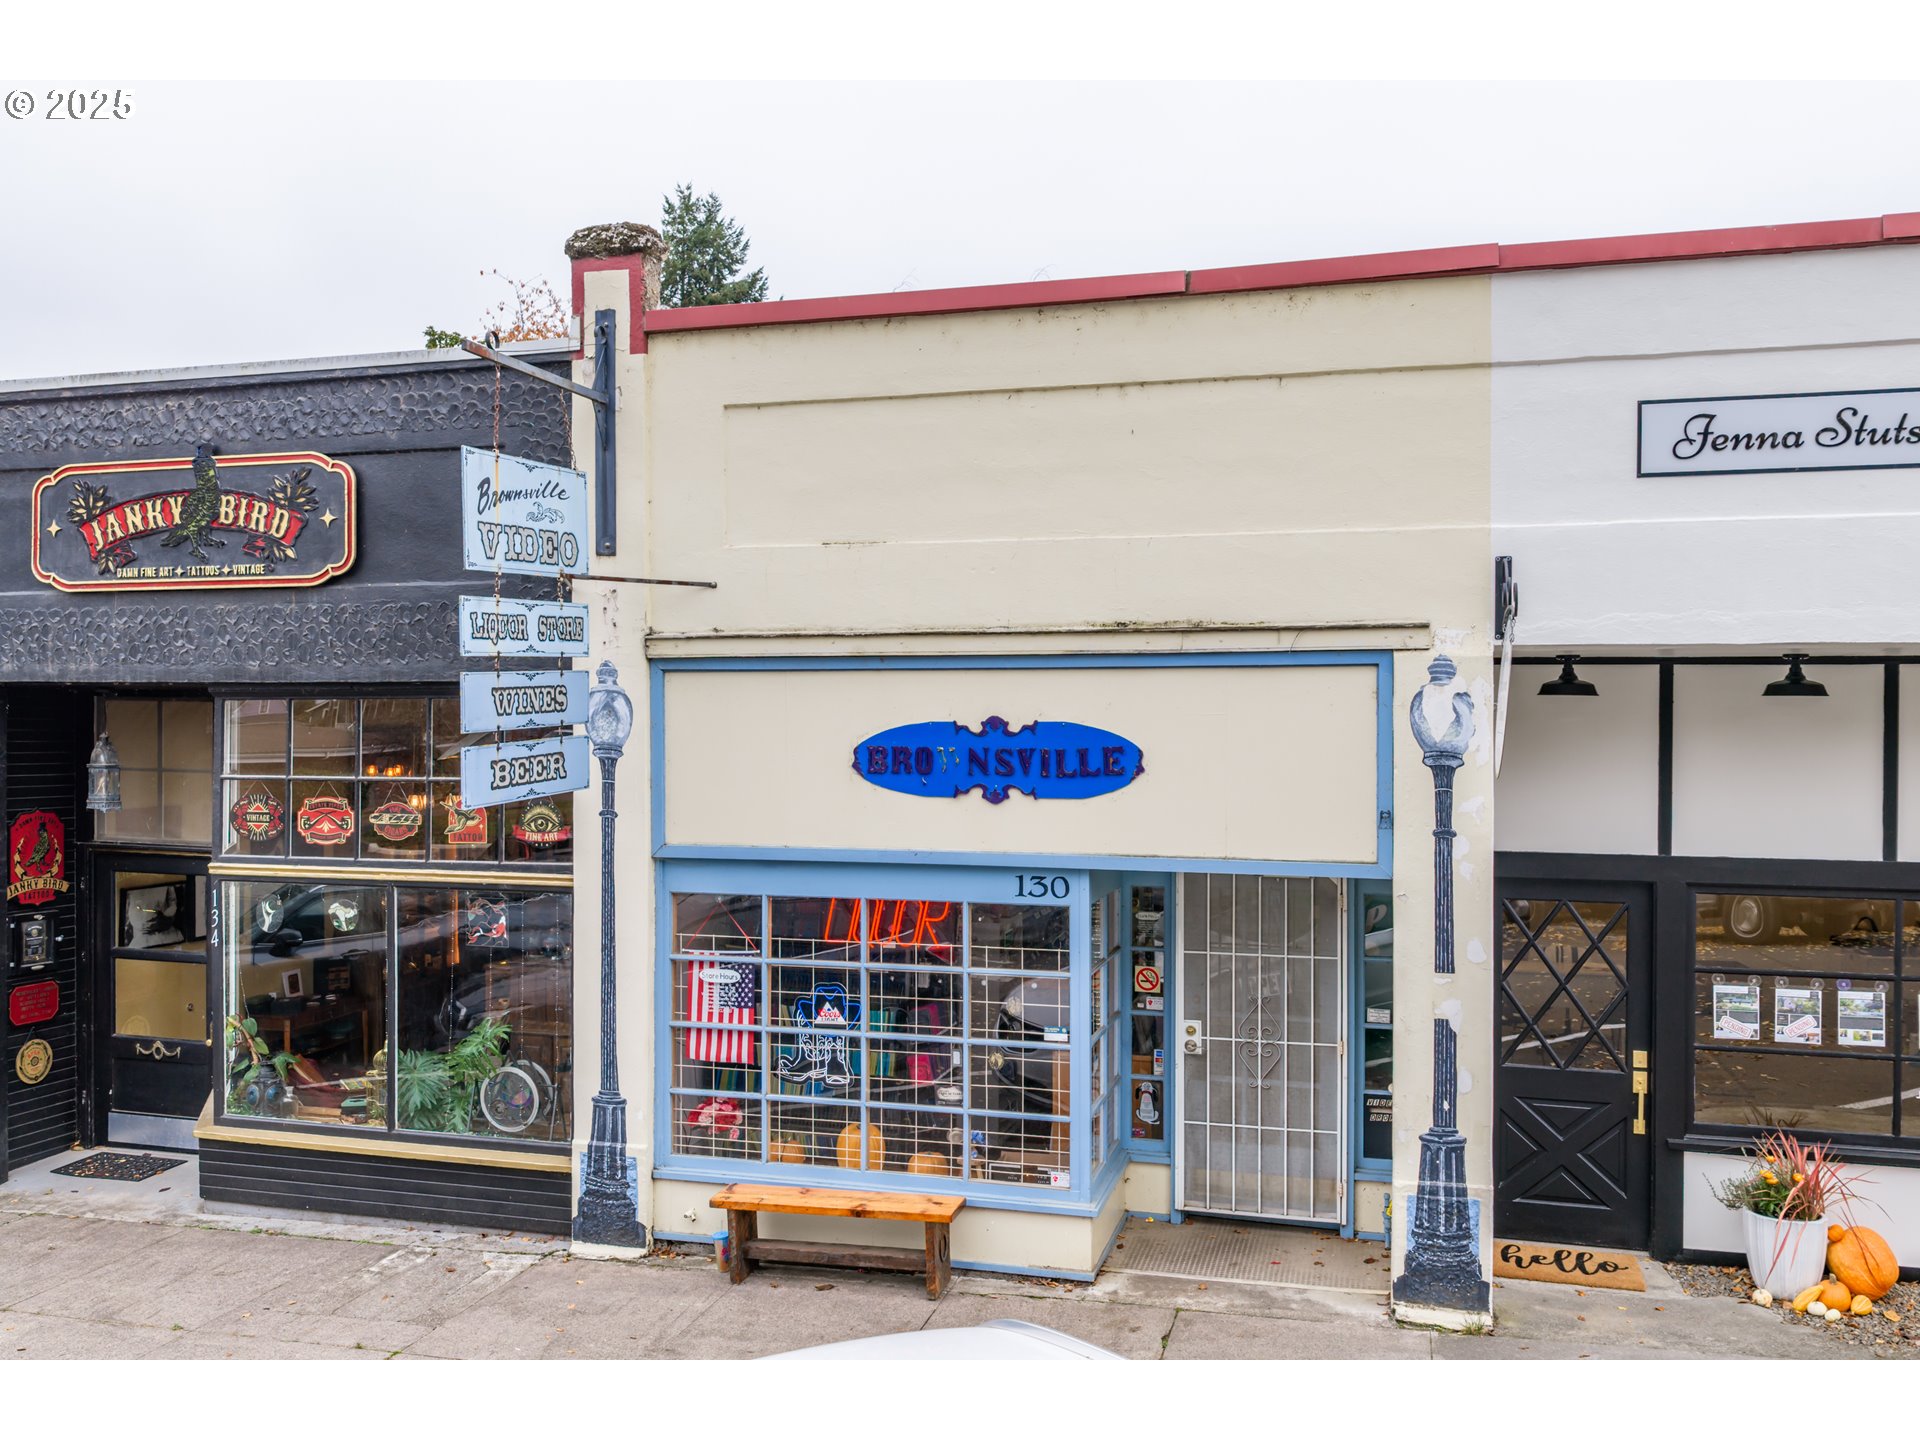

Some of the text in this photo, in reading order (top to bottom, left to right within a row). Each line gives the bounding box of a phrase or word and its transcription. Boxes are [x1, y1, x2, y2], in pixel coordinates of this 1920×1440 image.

[1672, 407, 1920, 460] Jenna Stuts
[477, 477, 571, 516] Brownsville
[93, 494, 292, 552] JANKY BIRD
[477, 521, 580, 568] VIDEO
[117, 563, 266, 578] DAMN FINE ART TATTOOS VINTAGE
[470, 611, 584, 645] LIQUOR STORE
[491, 684, 568, 717] WINES
[490, 751, 567, 791] BEER
[866, 745, 1126, 778] BRONSVILLE
[246, 814, 270, 822] VINTAGE
[452, 833, 483, 842] TATTOO
[525, 831, 559, 842] FINE ART
[8, 879, 64, 897] JANKY BIRD
[1015, 874, 1070, 899] 130
[210, 889, 219, 947] 134
[720, 972, 739, 981] Hours
[818, 1007, 841, 1018] Coors
[1723, 1020, 1749, 1037] PENDING
[1787, 1018, 1813, 1036] PENDING
[1500, 1244, 1629, 1275] hello
